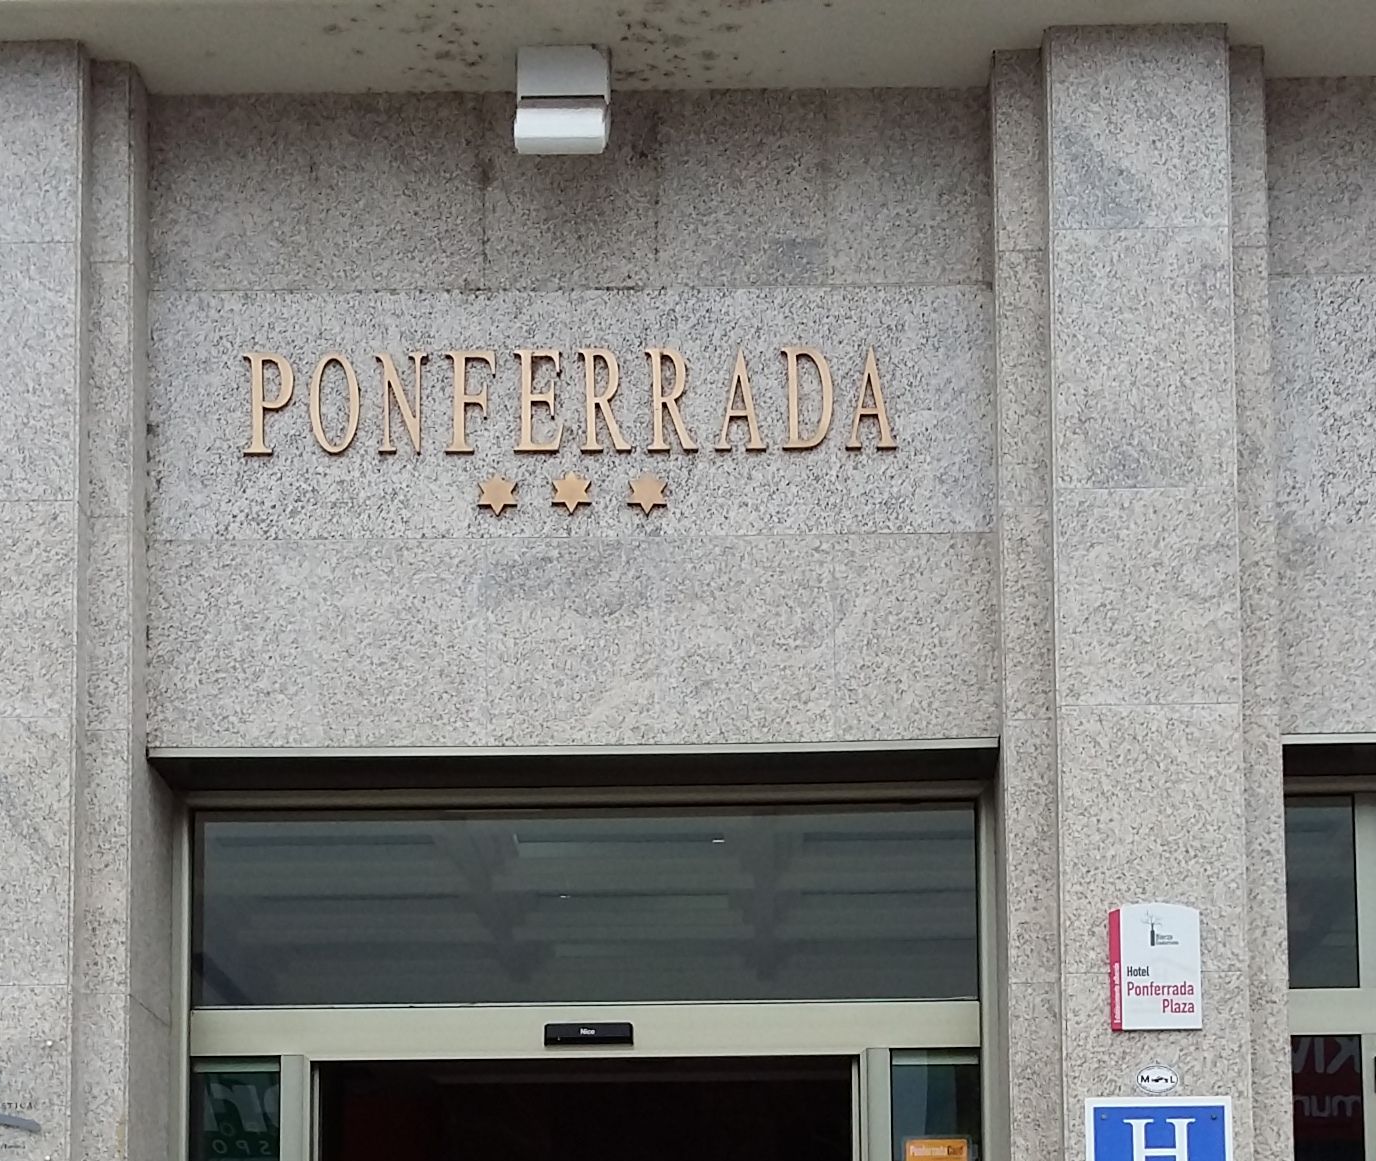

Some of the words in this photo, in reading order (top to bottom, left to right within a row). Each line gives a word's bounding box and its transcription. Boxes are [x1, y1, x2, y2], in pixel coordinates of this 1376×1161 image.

[242, 344, 897, 457] PONFERRADA
[1126, 966, 1150, 977] Hotel
[1127, 981, 1195, 997] Ponferrada
[1162, 998, 1195, 1014] Plaza
